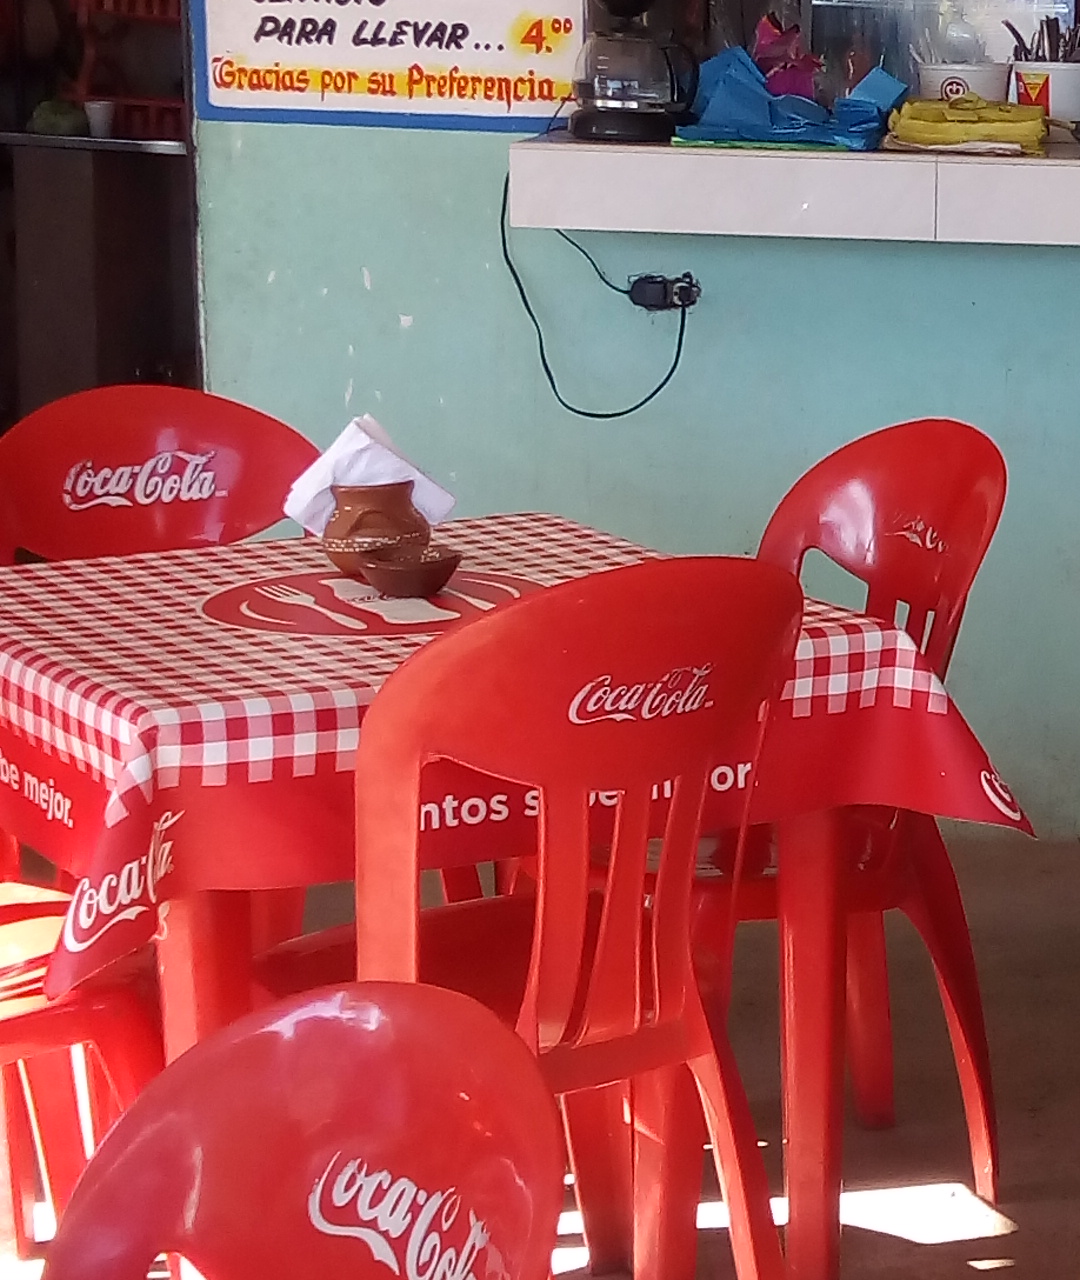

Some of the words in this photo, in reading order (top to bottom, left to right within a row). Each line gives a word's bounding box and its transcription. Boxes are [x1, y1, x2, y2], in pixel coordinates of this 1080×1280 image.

[253, 16, 337, 46] PARA
[352, 19, 470, 51] LLEVAR
[212, 57, 310, 93] Gracias
[320, 69, 357, 101] por
[366, 73, 397, 97] su
[407, 63, 557, 113] Preferencia
[63, 450, 215, 511] Coca-Cola
[568, 662, 712, 725] Coca-Cola
